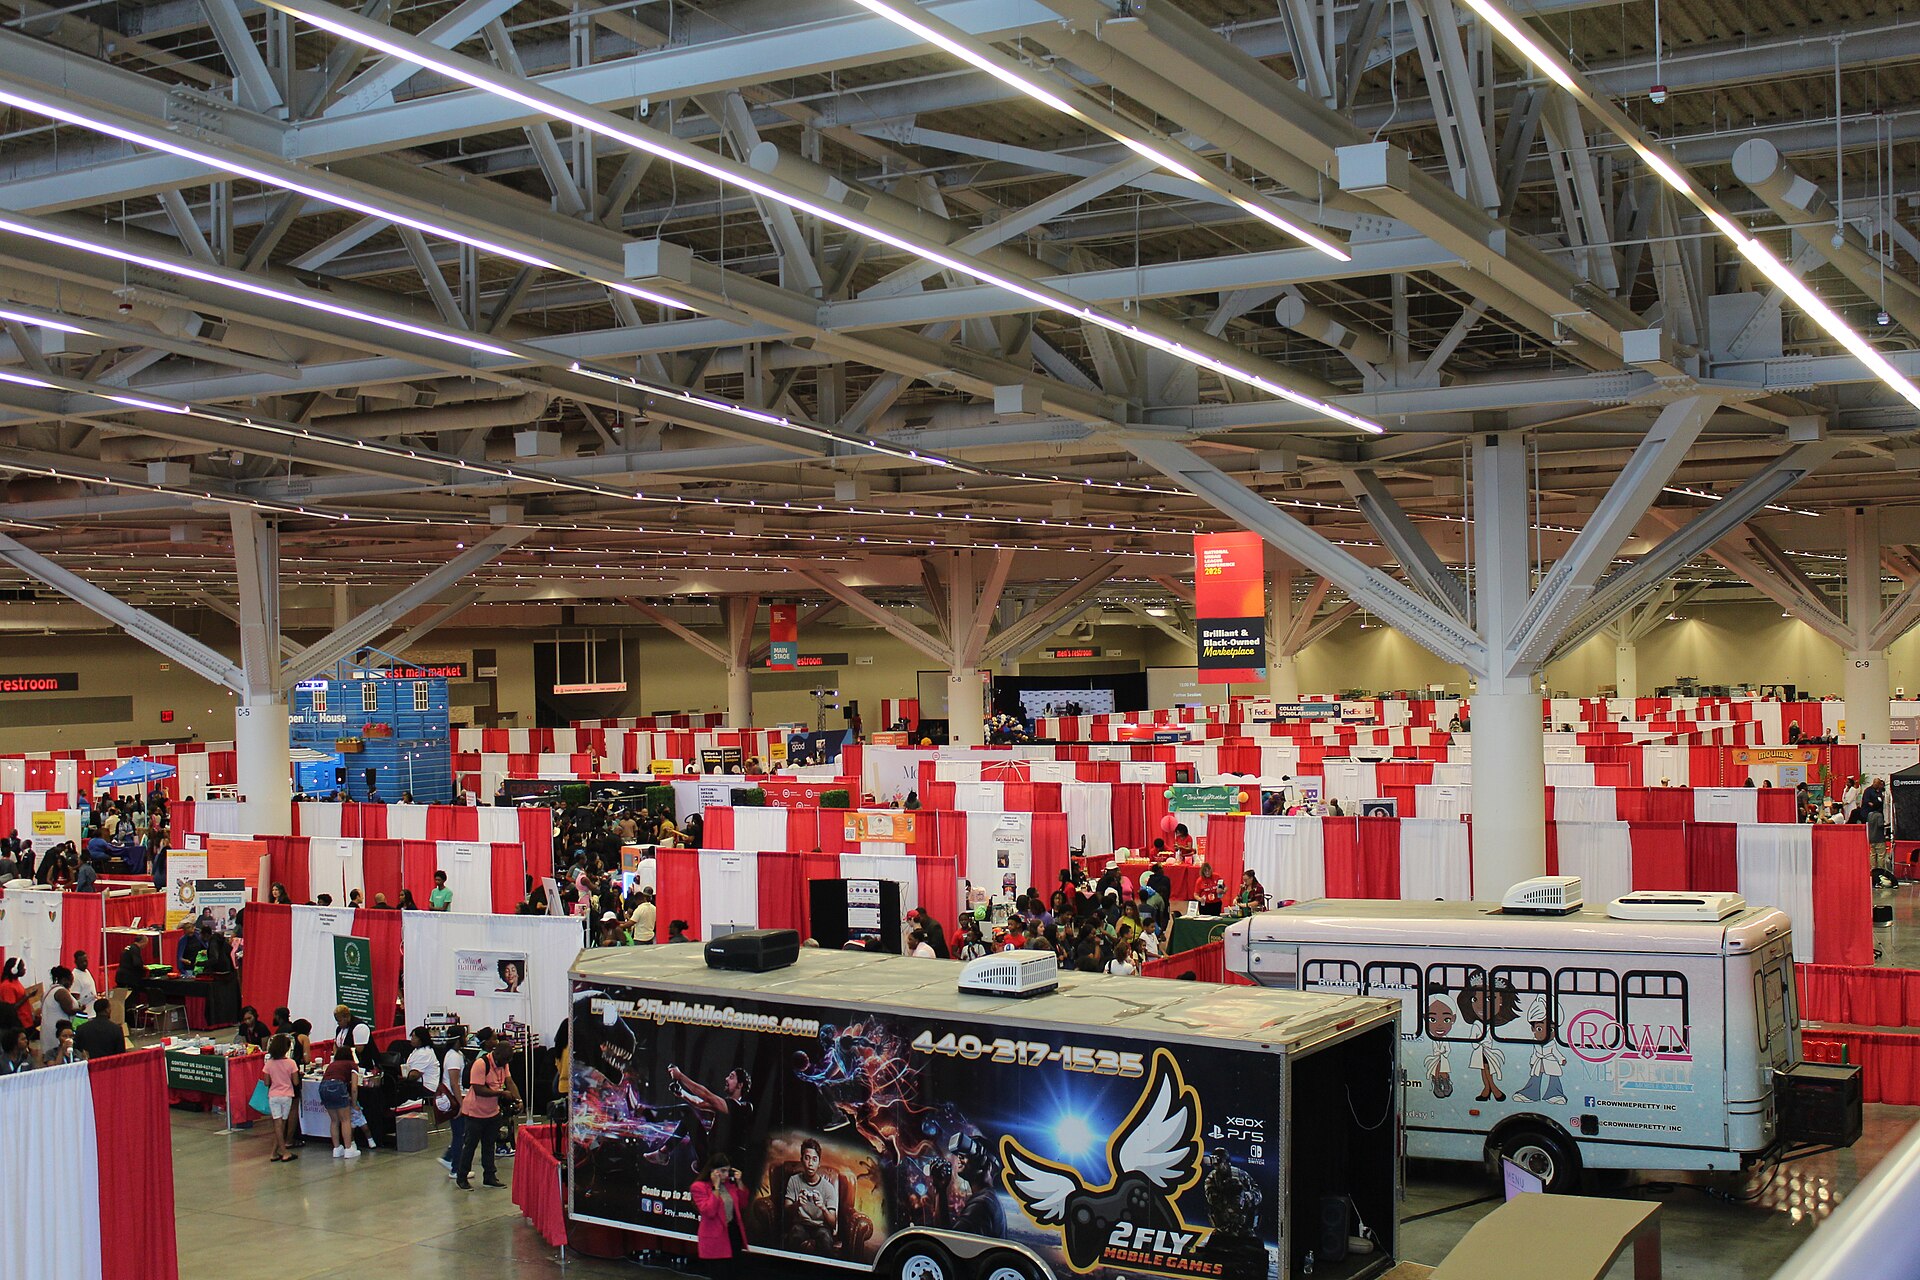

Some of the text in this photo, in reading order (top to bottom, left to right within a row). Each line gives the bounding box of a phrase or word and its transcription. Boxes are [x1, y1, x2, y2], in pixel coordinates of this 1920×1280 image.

[1203, 629, 1239, 638] Brilliant
[1203, 638, 1260, 647] Black-Owned
[1203, 646, 1255, 658] Marketplace
[797, 656, 822, 666] estroom
[428, 665, 461, 677] market
[238, 708, 250, 716] C-5
[289, 714, 304, 725] pen
[320, 713, 347, 723] House
[791, 743, 805, 752] good
[1318, 978, 1413, 991] Birthday Parties
[590, 998, 820, 1038] www.2FlyMobileGames.com
[1567, 1009, 1692, 1062] CROWN
[912, 1030, 1144, 1078] 440-317-1535
[1596, 1100, 1661, 1110] CROWNMEPRETTY
[1404, 1111, 1428, 1119] oday
[1226, 1116, 1264, 1128] XBOX
[1227, 1129, 1264, 1142] PS5
[1506, 1170, 1524, 1188] MENU
[641, 1185, 660, 1197] Seats
[661, 1190, 672, 1200] up
[673, 1190, 681, 1199] to
[1104, 1247, 1223, 1275] MOBILE GAMES
